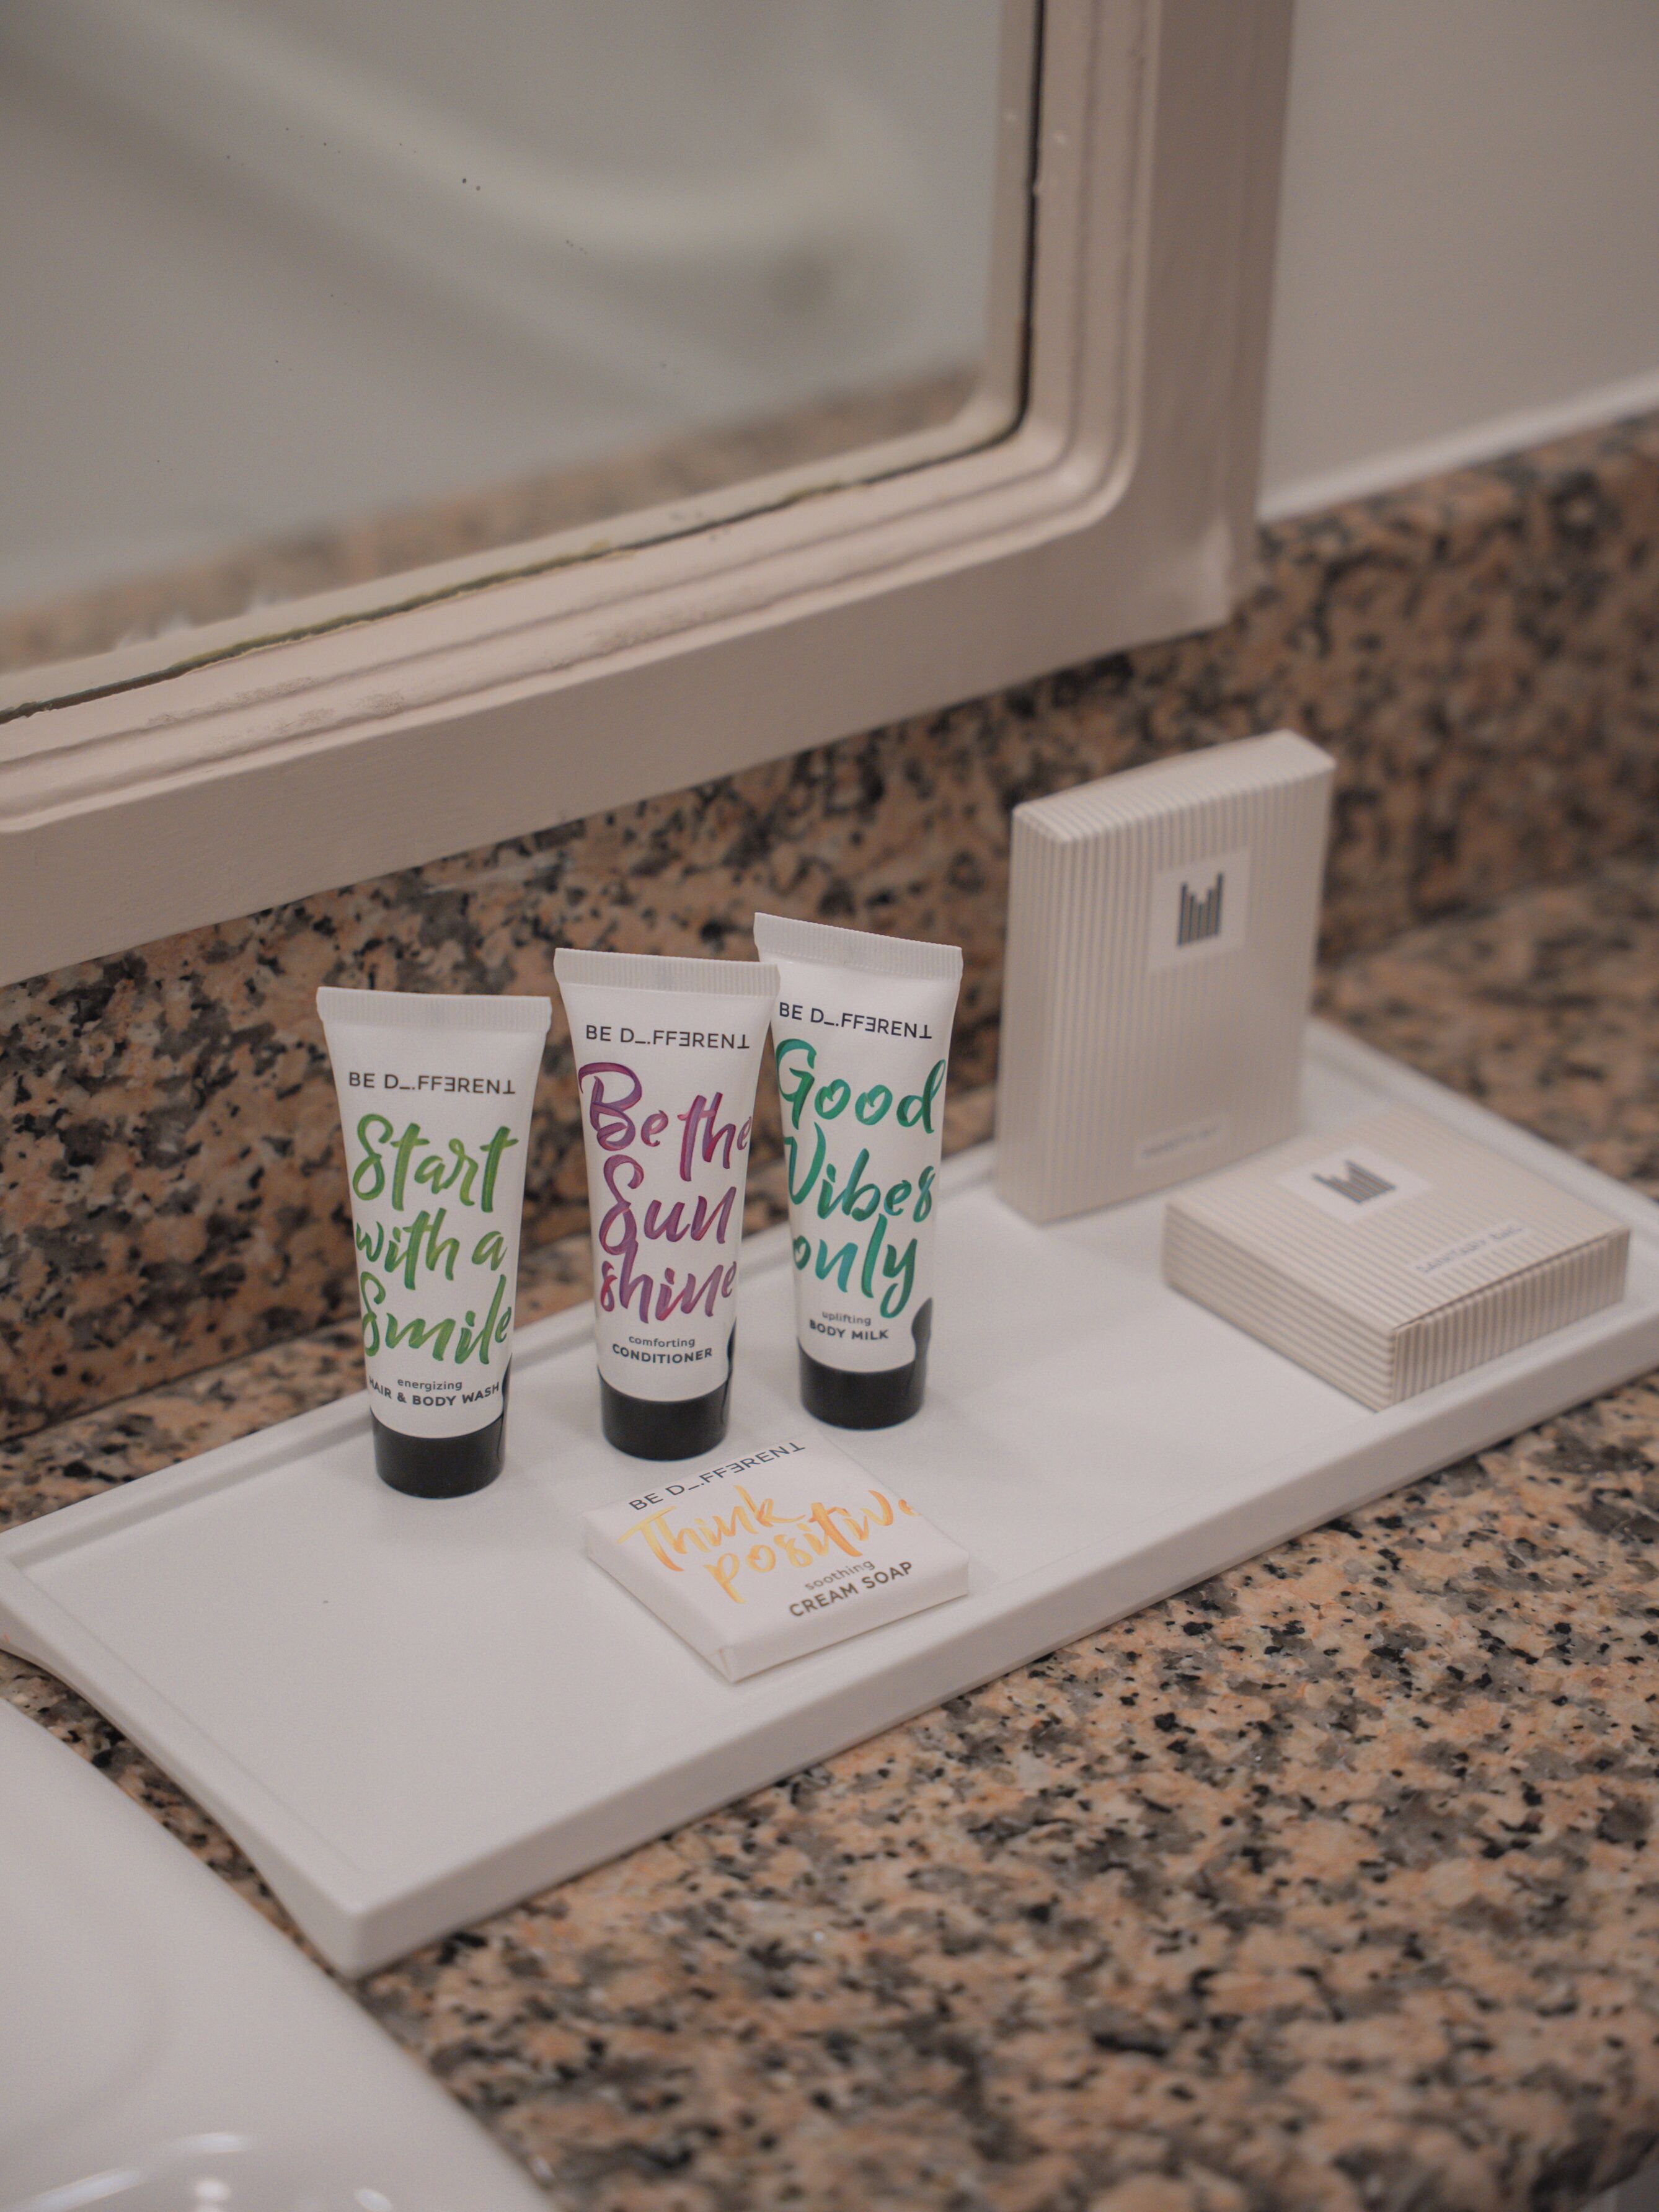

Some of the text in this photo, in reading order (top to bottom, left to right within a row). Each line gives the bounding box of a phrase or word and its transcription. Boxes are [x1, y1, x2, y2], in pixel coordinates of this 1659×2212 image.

[779, 1002, 803, 1020] BE
[586, 1025, 612, 1042] BE
[348, 1071, 375, 1089] BE
[776, 1038, 947, 1134] Good
[578, 1061, 752, 1182] Be the
[352, 1113, 519, 1213] Start
[784, 1121, 936, 1223] Vibes
[599, 1154, 737, 1256] Sun
[356, 1207, 508, 1291] with a
[792, 1213, 918, 1319] only
[600, 1239, 738, 1324] shine
[360, 1271, 512, 1365] Smile
[809, 1319, 890, 1341] BODY MILK
[821, 1311, 872, 1327] uplifting
[612, 1343, 713, 1365] CONDITIONER
[628, 1335, 696, 1348] comforting
[397, 1377, 462, 1392] energizing
[397, 1392, 407, 1404] &
[412, 1395, 456, 1407] BODY
[462, 1381, 500, 1405] WASH
[628, 1492, 664, 1511] BE
[619, 1484, 806, 1572] Think
[788, 1560, 914, 1617] CREAM SOAP
[805, 1559, 876, 1591] soothing
